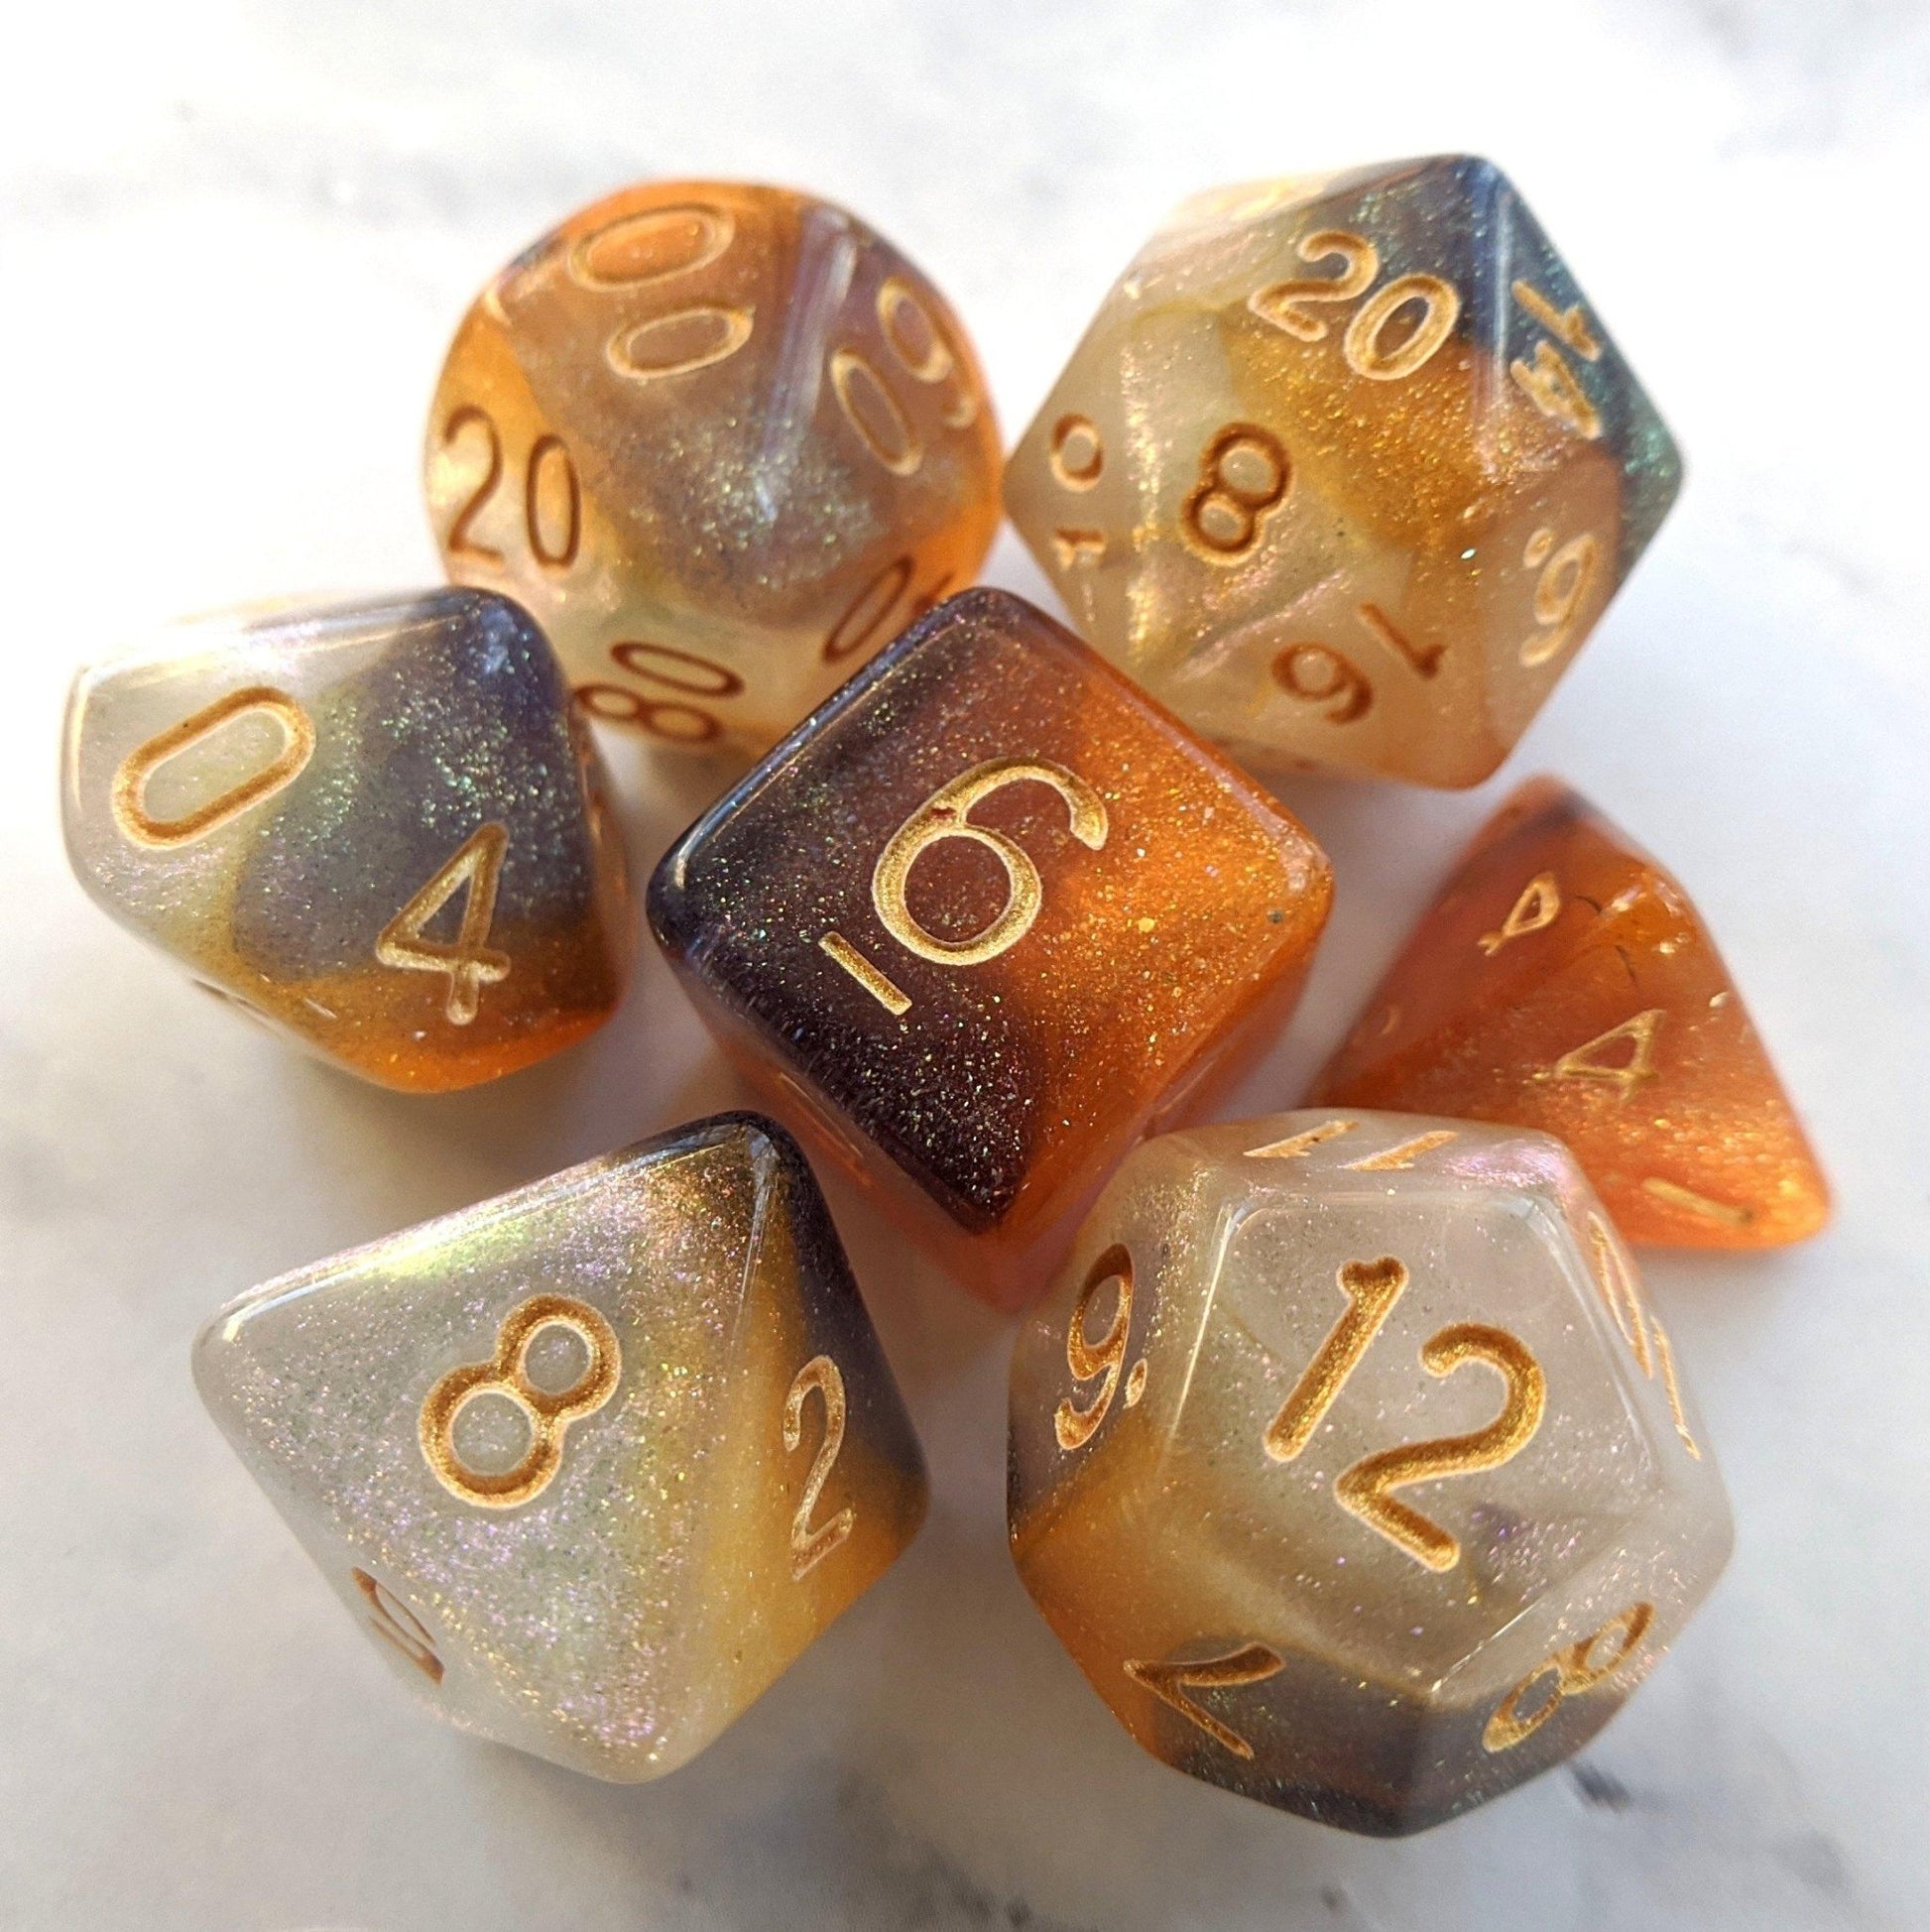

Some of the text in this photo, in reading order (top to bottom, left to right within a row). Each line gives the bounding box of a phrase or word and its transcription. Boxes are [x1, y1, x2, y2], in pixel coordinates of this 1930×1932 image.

[1248, 230, 1460, 381] 20
[442, 405, 581, 569] 20
[1181, 423, 1293, 567] 8
[111, 685, 316, 851] 0
[375, 822, 511, 1026] 4
[1554, 1009, 1666, 1103] 4
[419, 1295, 622, 1509] 8
[784, 1355, 853, 1581] 2
[1263, 1256, 1546, 1573] 12
[1483, 1602, 1655, 1752] 8
